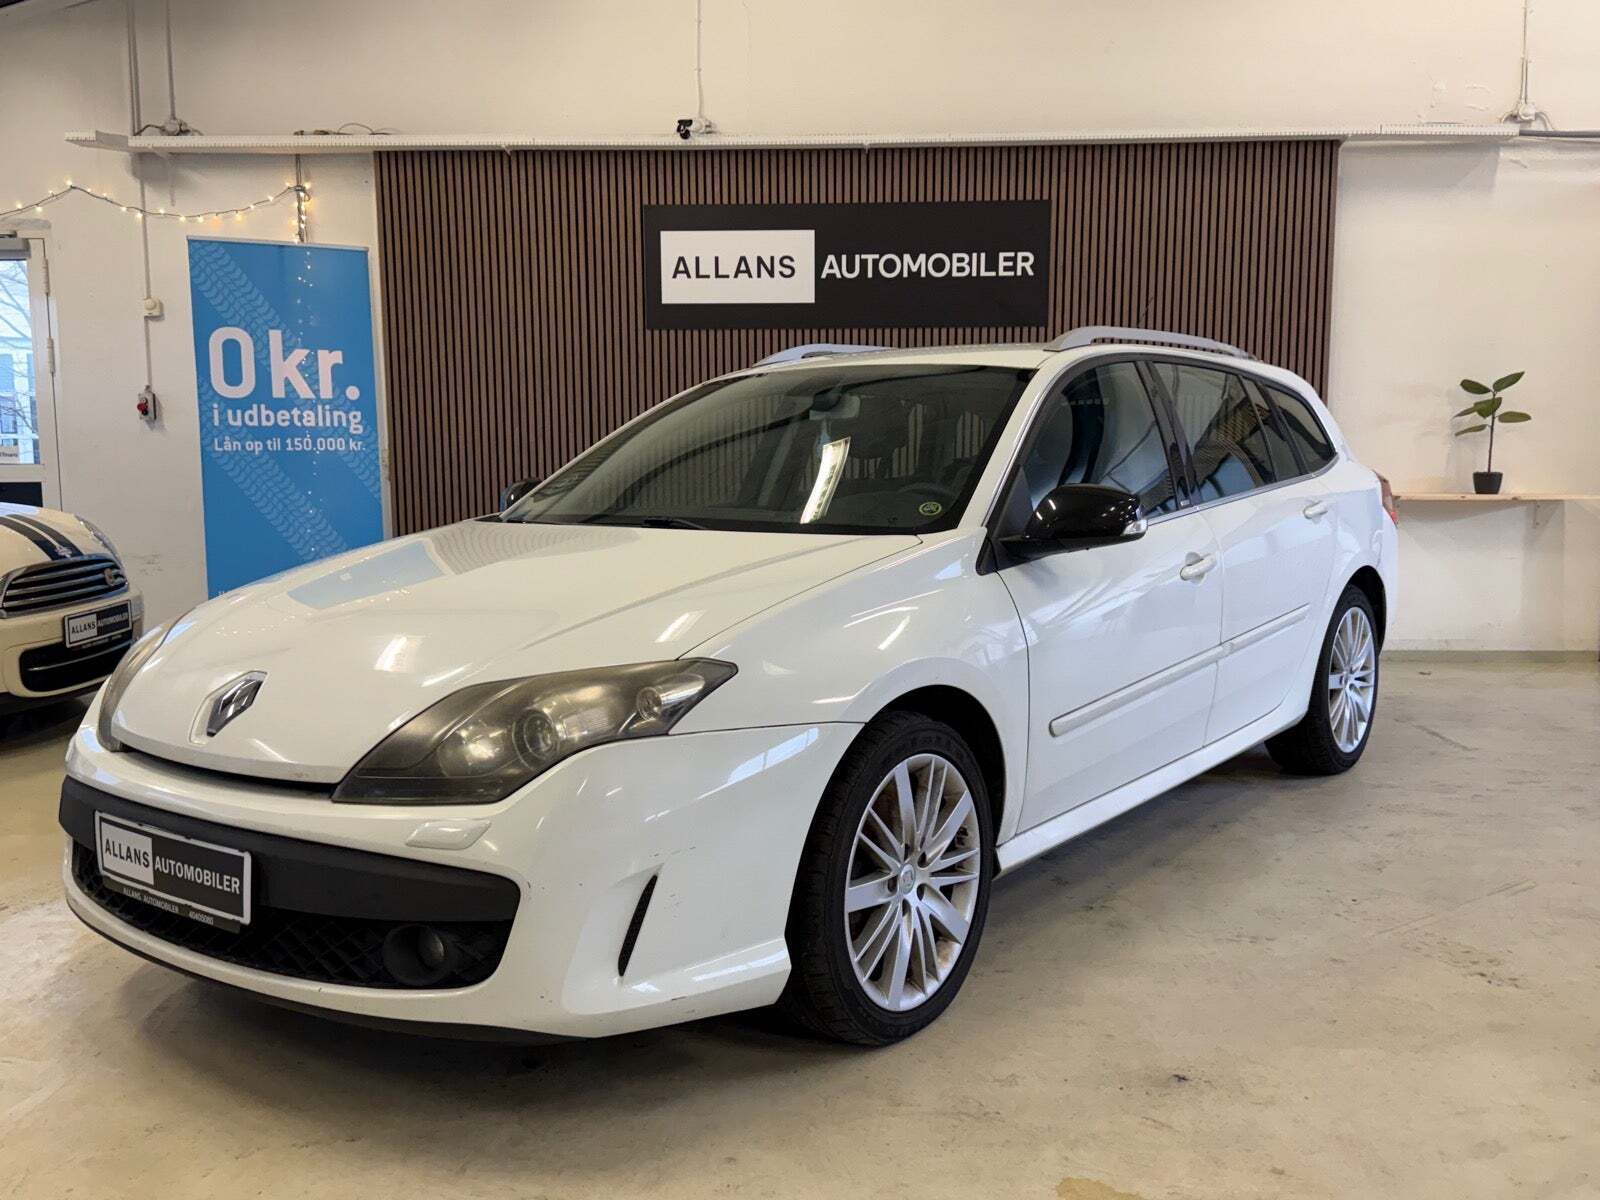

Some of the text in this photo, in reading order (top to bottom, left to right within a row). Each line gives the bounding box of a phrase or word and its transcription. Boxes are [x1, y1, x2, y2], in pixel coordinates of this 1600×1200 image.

[672, 251, 1035, 280] ALLANS AUTOMOBILER
[208, 326, 360, 400] 0 kr.
[212, 403, 363, 435] i udbetaling
[214, 435, 366, 455] Lån op til 150.000 kr.
[71, 621, 96, 634] ALLANS
[105, 838, 240, 895] ALLANS AUTOMOBILER
